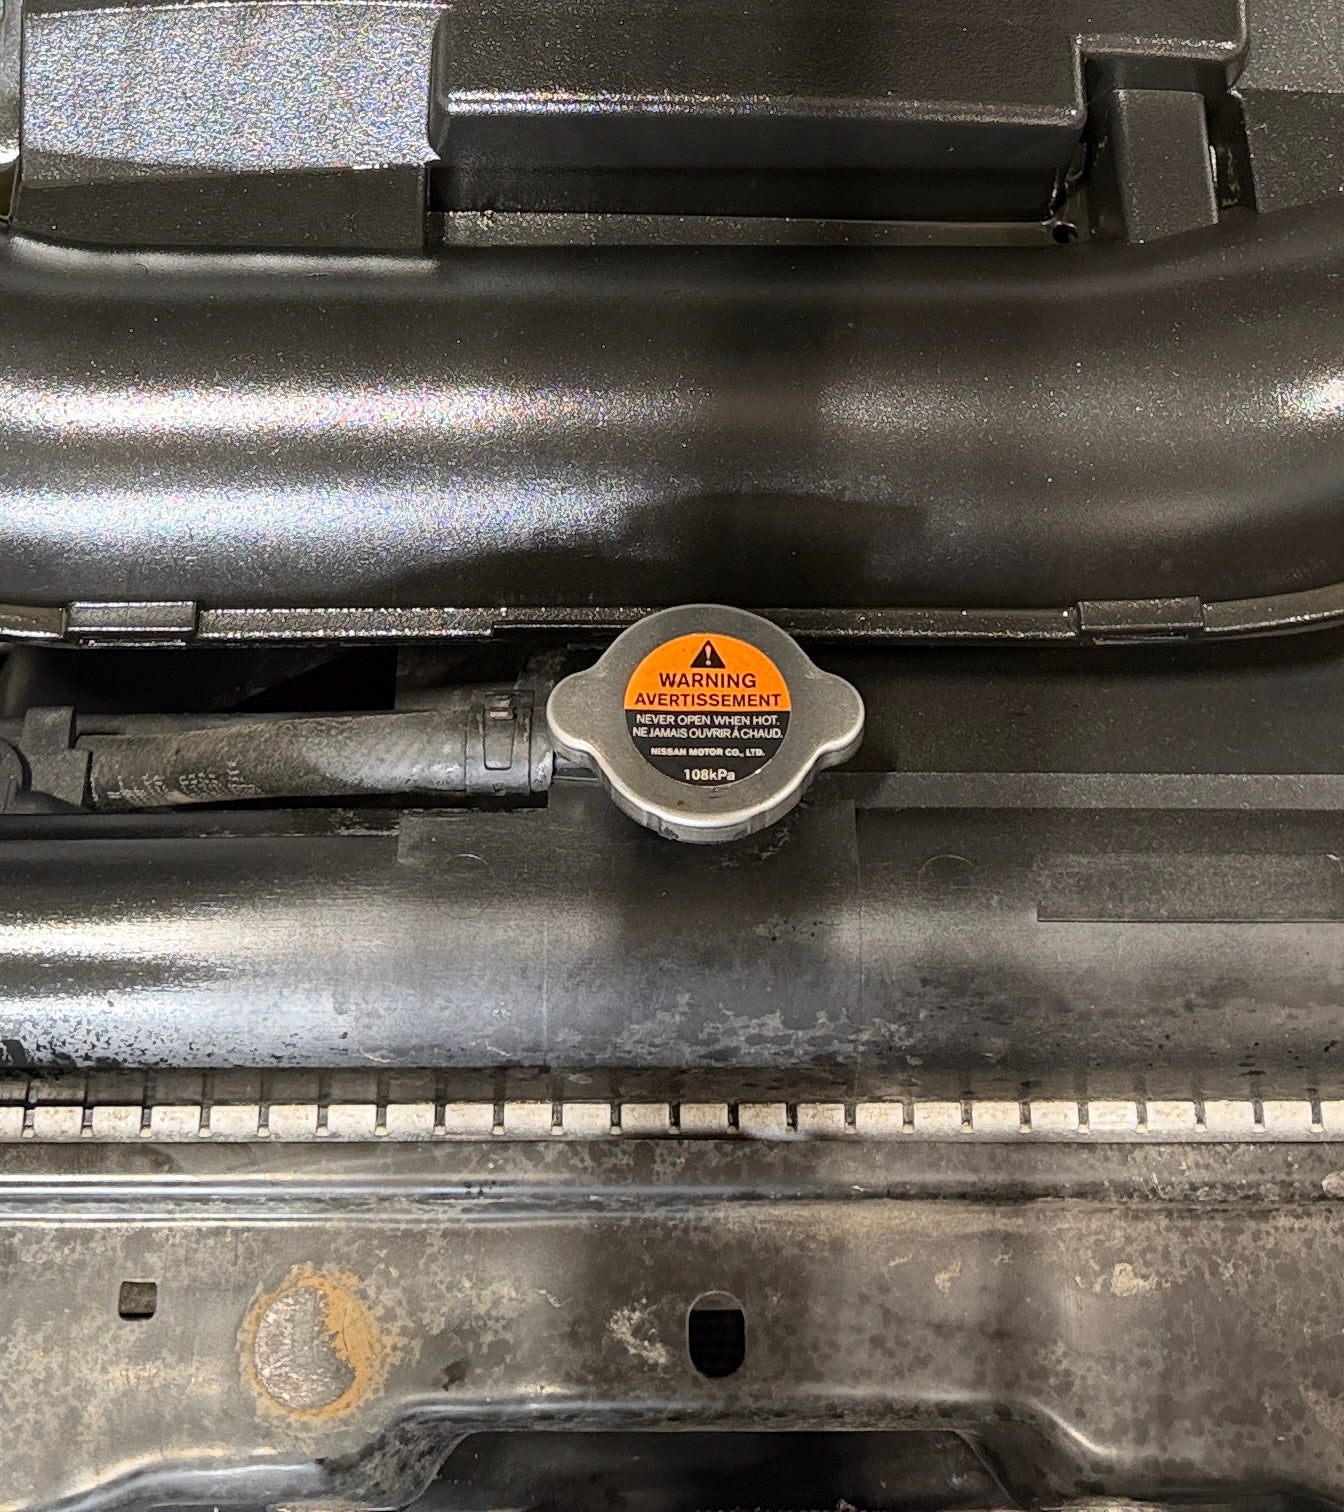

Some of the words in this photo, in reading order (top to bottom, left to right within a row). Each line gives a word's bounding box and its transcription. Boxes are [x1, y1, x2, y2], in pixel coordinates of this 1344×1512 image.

[659, 672, 757, 689] WARNING
[634, 692, 782, 707] AVERTISSEMENT
[636, 714, 675, 726] NEVER
[677, 714, 710, 726] OPEN
[713, 715, 752, 726] WHEN
[752, 715, 780, 726] HOT.
[632, 727, 648, 738] NE
[648, 727, 688, 738] JAMAIS
[688, 728, 732, 739] OUVRIR
[740, 727, 784, 739] CHAUD.
[650, 747, 687, 756] NISSAN
[688, 747, 723, 757] MOTOR
[746, 748, 765, 757] LTD.
[683, 768, 736, 781] 108kPa
